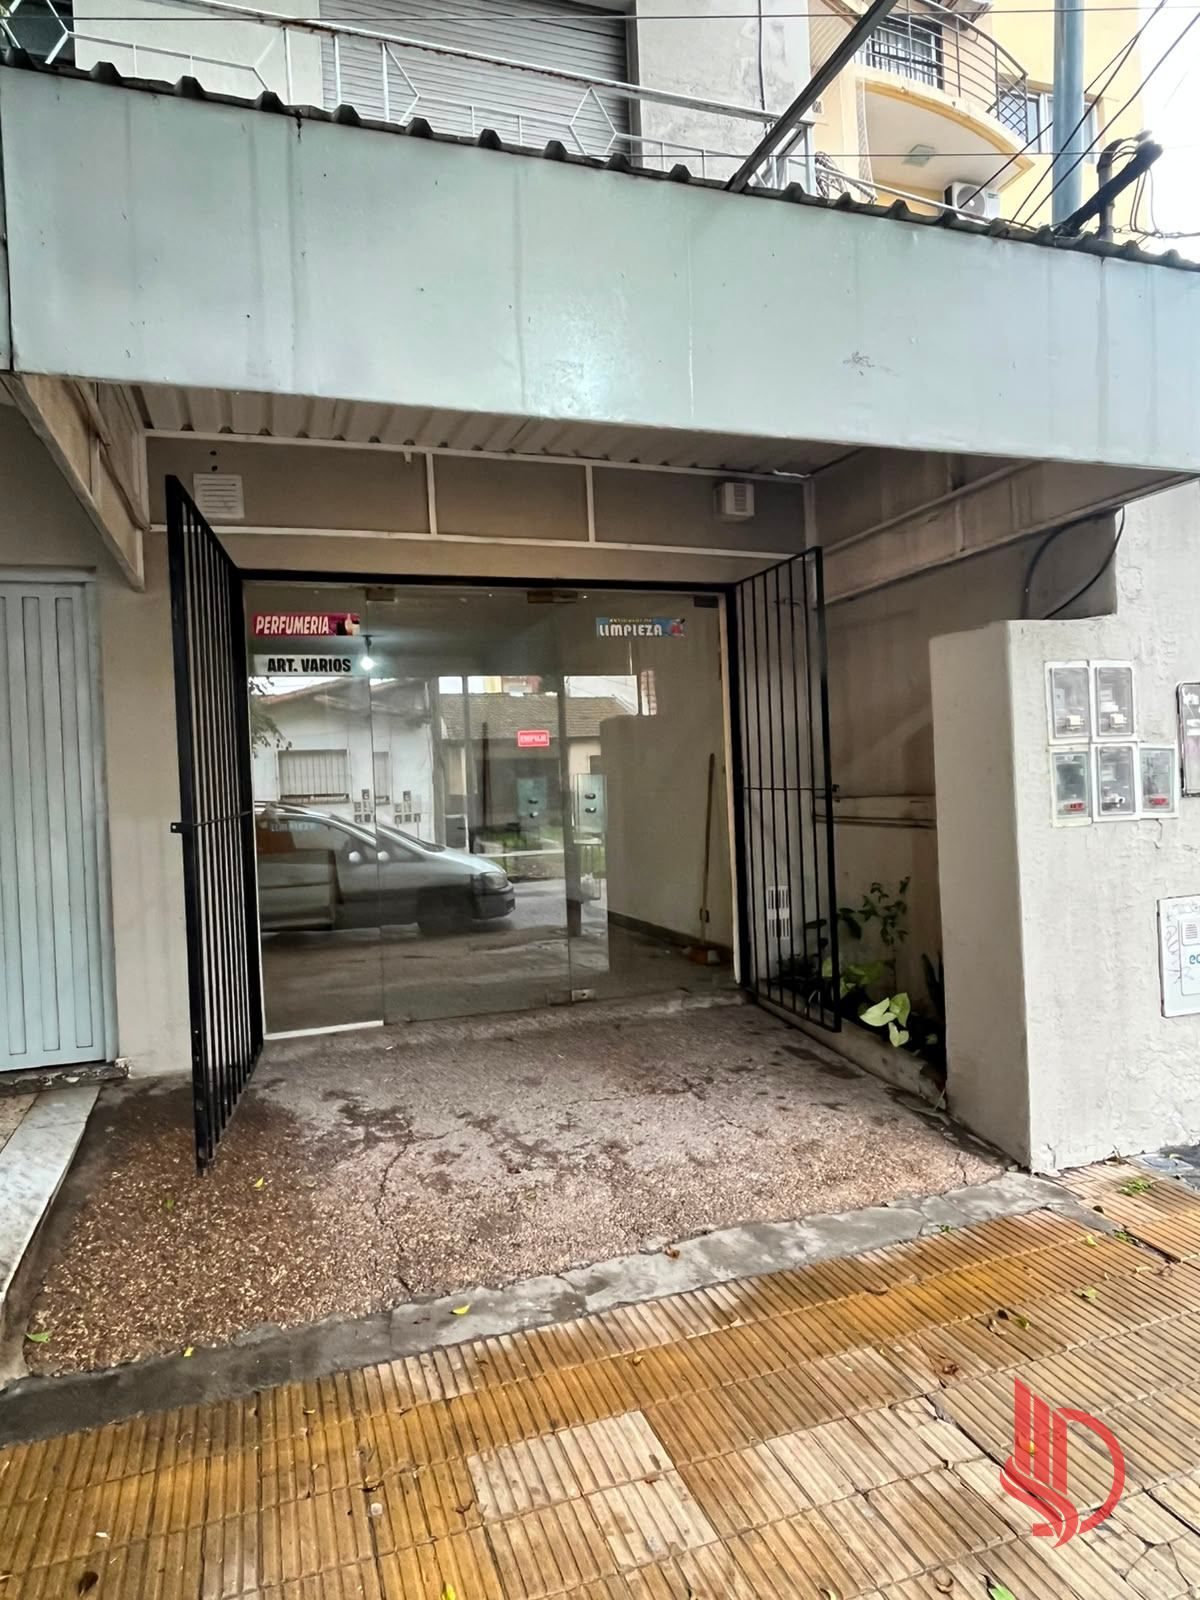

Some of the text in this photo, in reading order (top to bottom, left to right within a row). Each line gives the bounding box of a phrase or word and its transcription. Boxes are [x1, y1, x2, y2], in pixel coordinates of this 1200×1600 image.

[255, 615, 330, 635] PERFUMERIA
[599, 624, 663, 637] LIMPIEZA
[267, 658, 352, 673] ART. VARIOS
